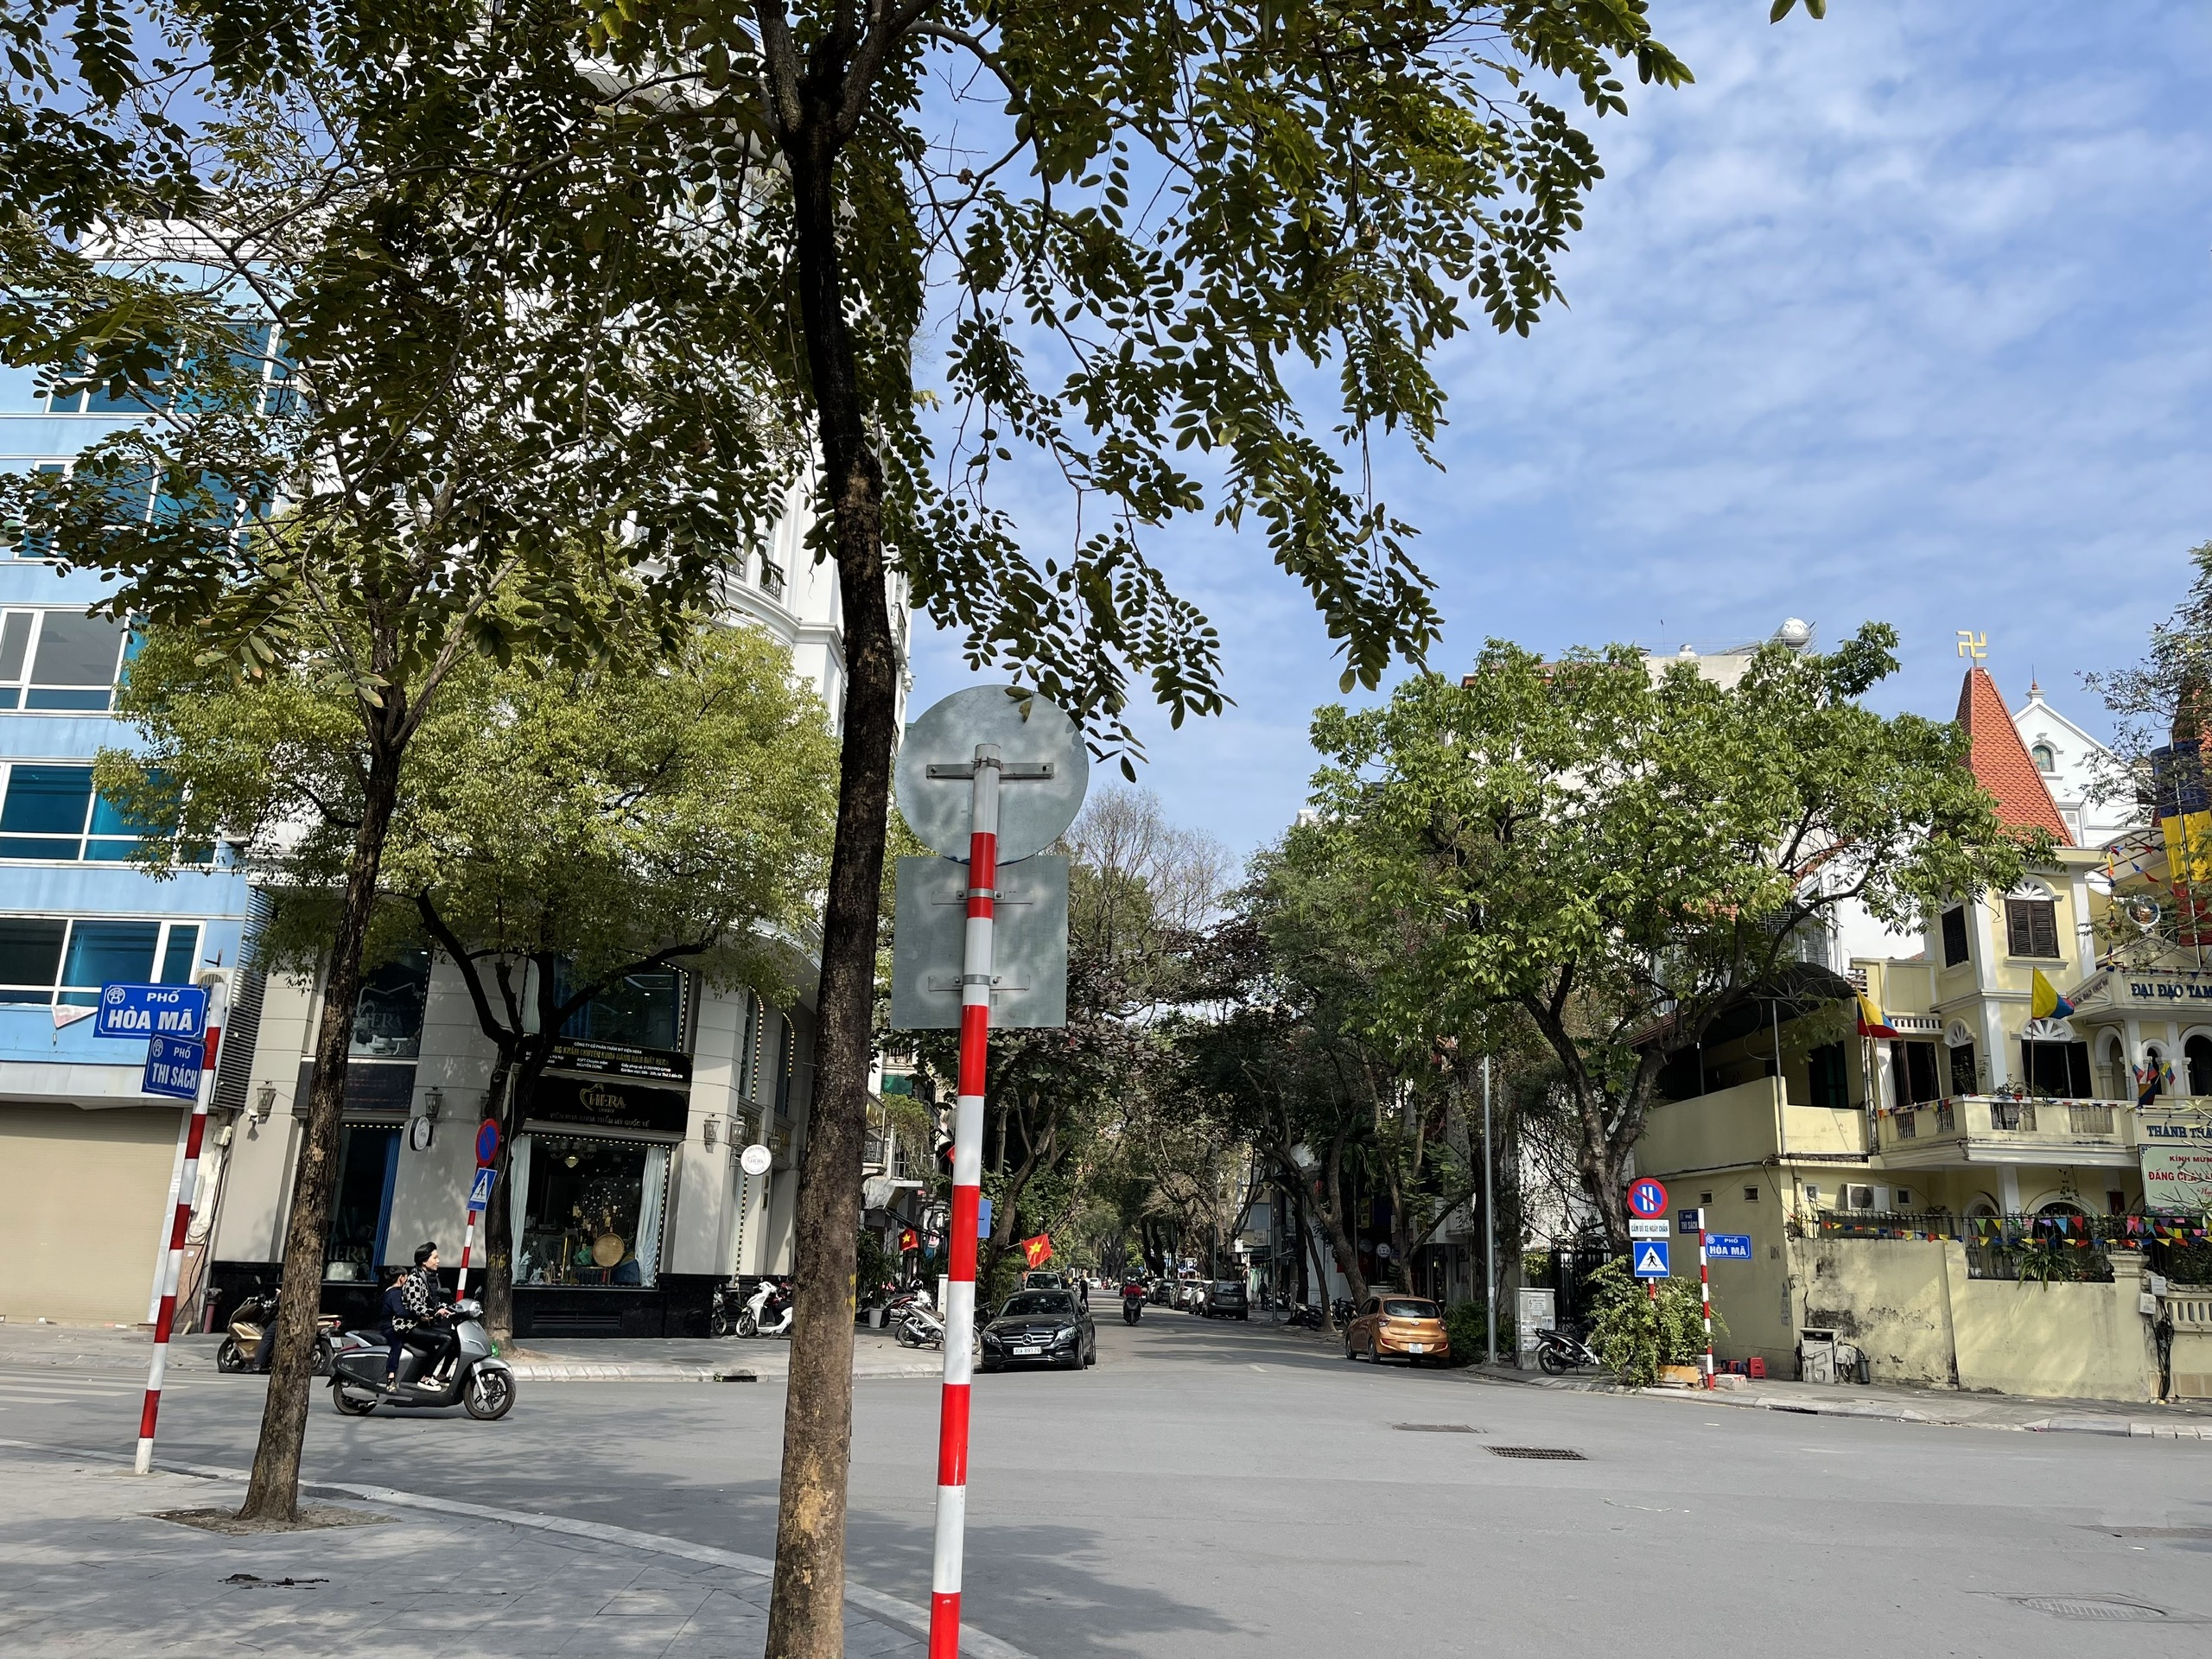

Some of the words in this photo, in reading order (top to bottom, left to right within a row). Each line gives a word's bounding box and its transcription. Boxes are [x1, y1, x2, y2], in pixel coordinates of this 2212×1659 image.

[146, 989, 181, 1003] PHỐ
[2131, 983, 2154, 1000] ĐẠI
[2157, 983, 2184, 1001] ĐẠO
[107, 1005, 151, 1030] HÒA
[157, 1008, 193, 1031] MÃ
[173, 1046, 192, 1059] PHỐ
[151, 1063, 170, 1084] THI
[170, 1063, 198, 1090] SÁCH
[588, 1092, 627, 1109] HERA
[2146, 1122, 2188, 1138] THÁNH
[2148, 1168, 2175, 1181] ĐẤNG
[1709, 1245, 1728, 1255] HÒA
[1731, 1245, 1747, 1255] MÃ
